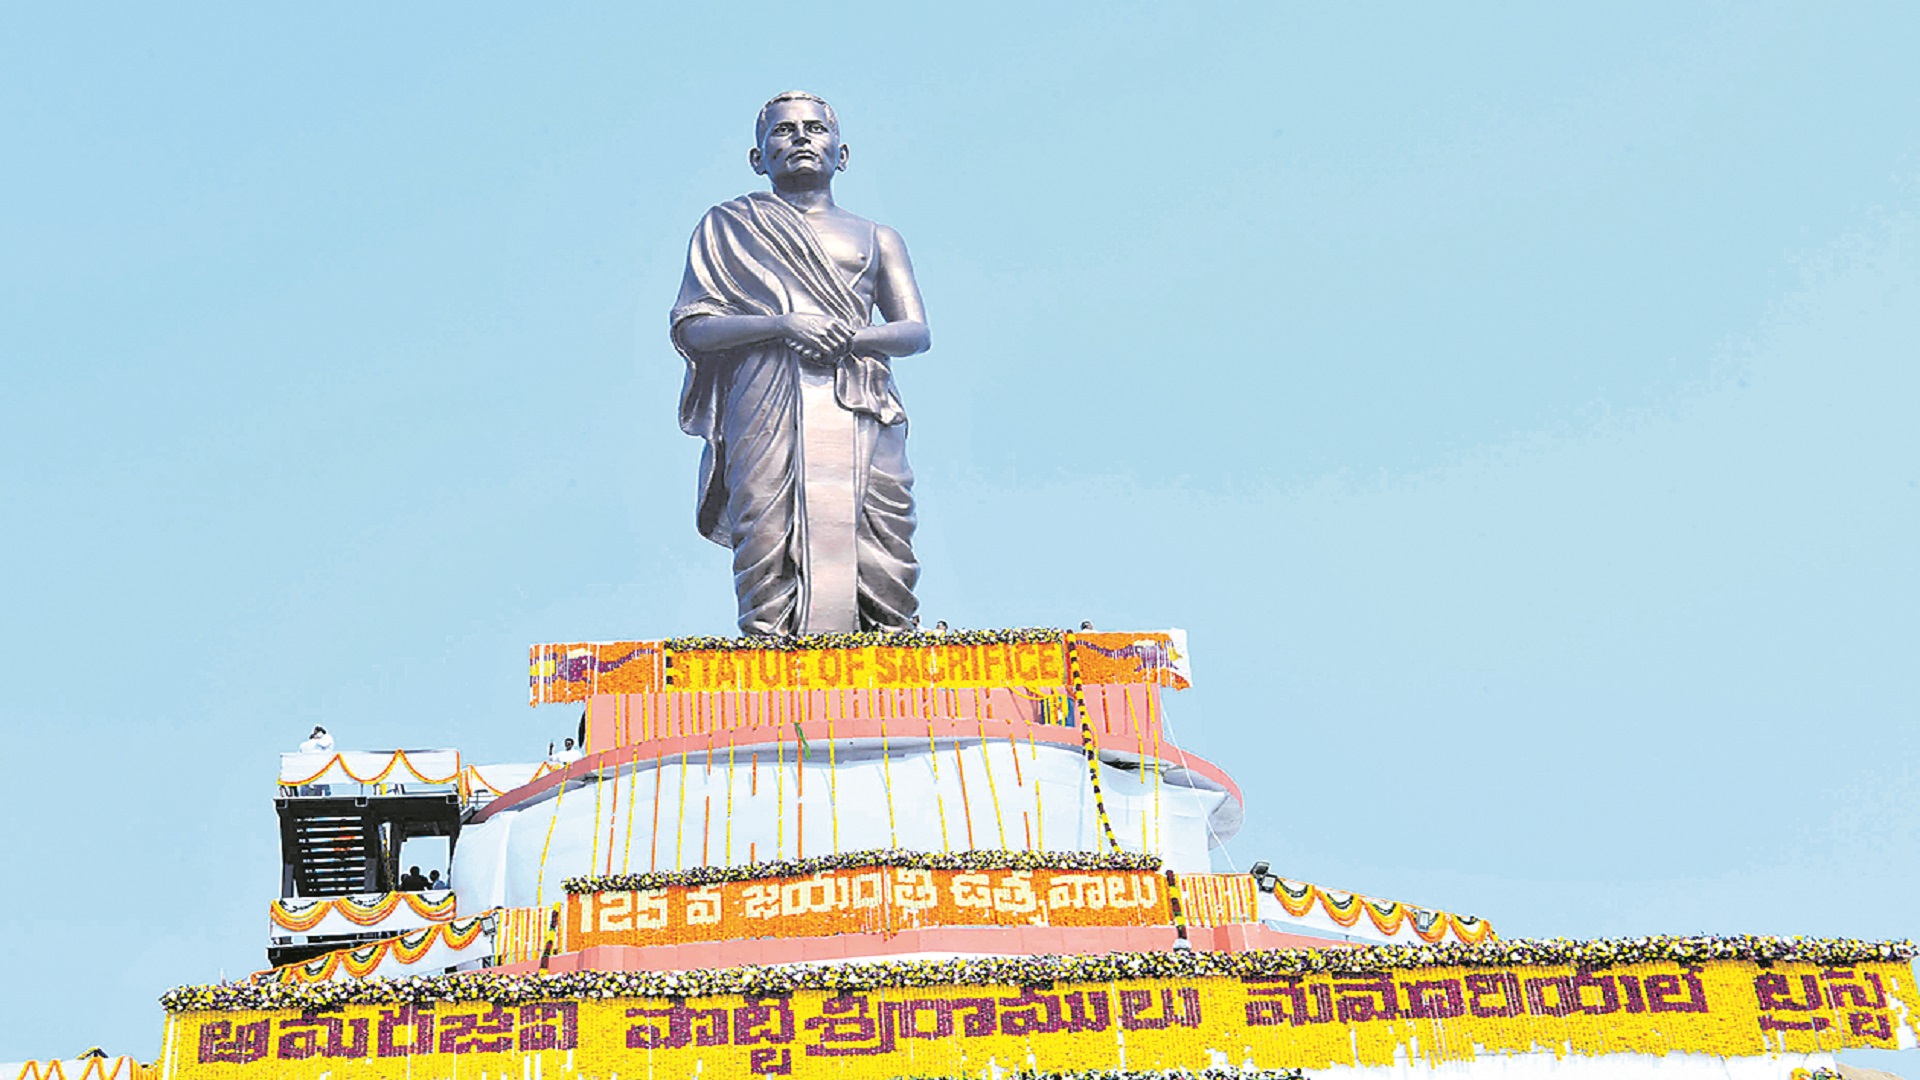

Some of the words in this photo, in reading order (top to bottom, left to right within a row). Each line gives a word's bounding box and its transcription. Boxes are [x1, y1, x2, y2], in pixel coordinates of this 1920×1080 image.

[671, 650, 810, 689] STATUE
[818, 649, 865, 684] OF
[876, 643, 1062, 683] SACRIFICE
[579, 889, 668, 933] 125
